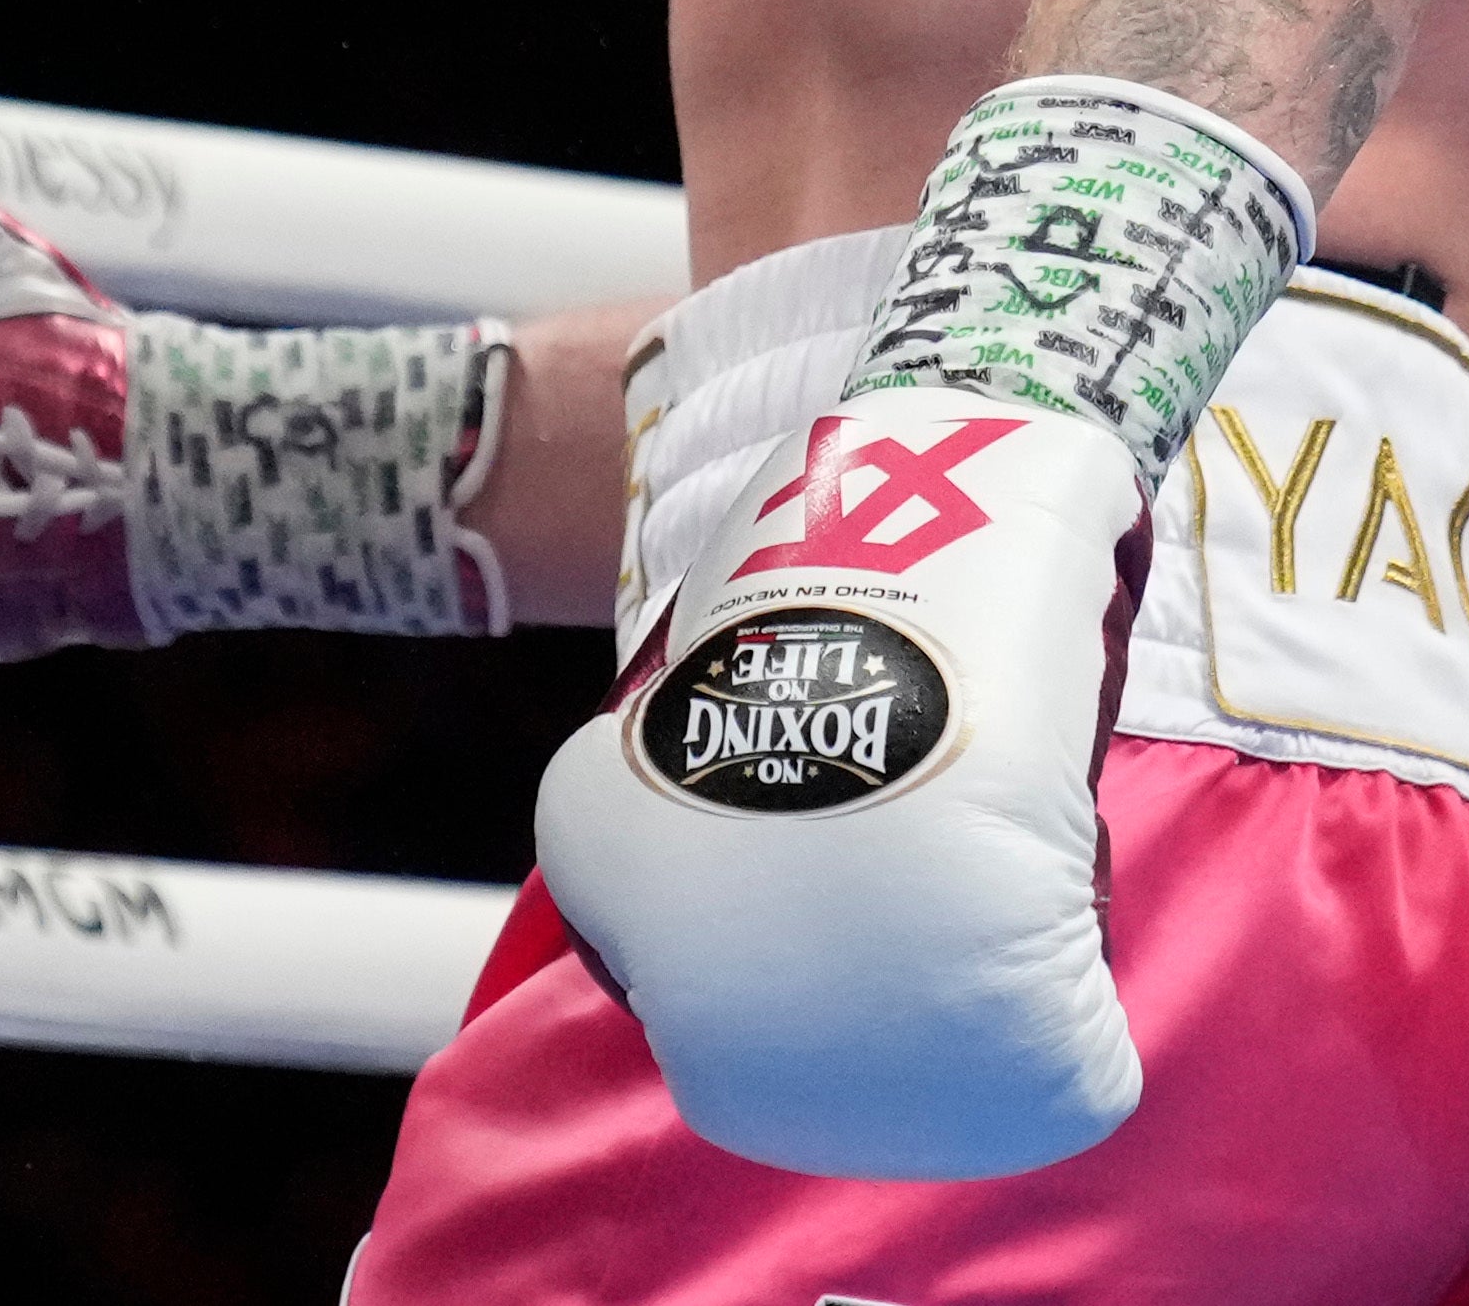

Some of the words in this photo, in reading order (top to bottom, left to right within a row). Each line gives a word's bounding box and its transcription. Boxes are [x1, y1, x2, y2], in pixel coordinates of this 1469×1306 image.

[710, 587, 789, 616] MEXICO
[795, 585, 827, 597] EN
[835, 585, 919, 604] HECHO
[731, 640, 862, 686] LIFE
[767, 679, 810, 702] NO
[682, 694, 895, 775] BOXING
[758, 757, 805, 785] NO
